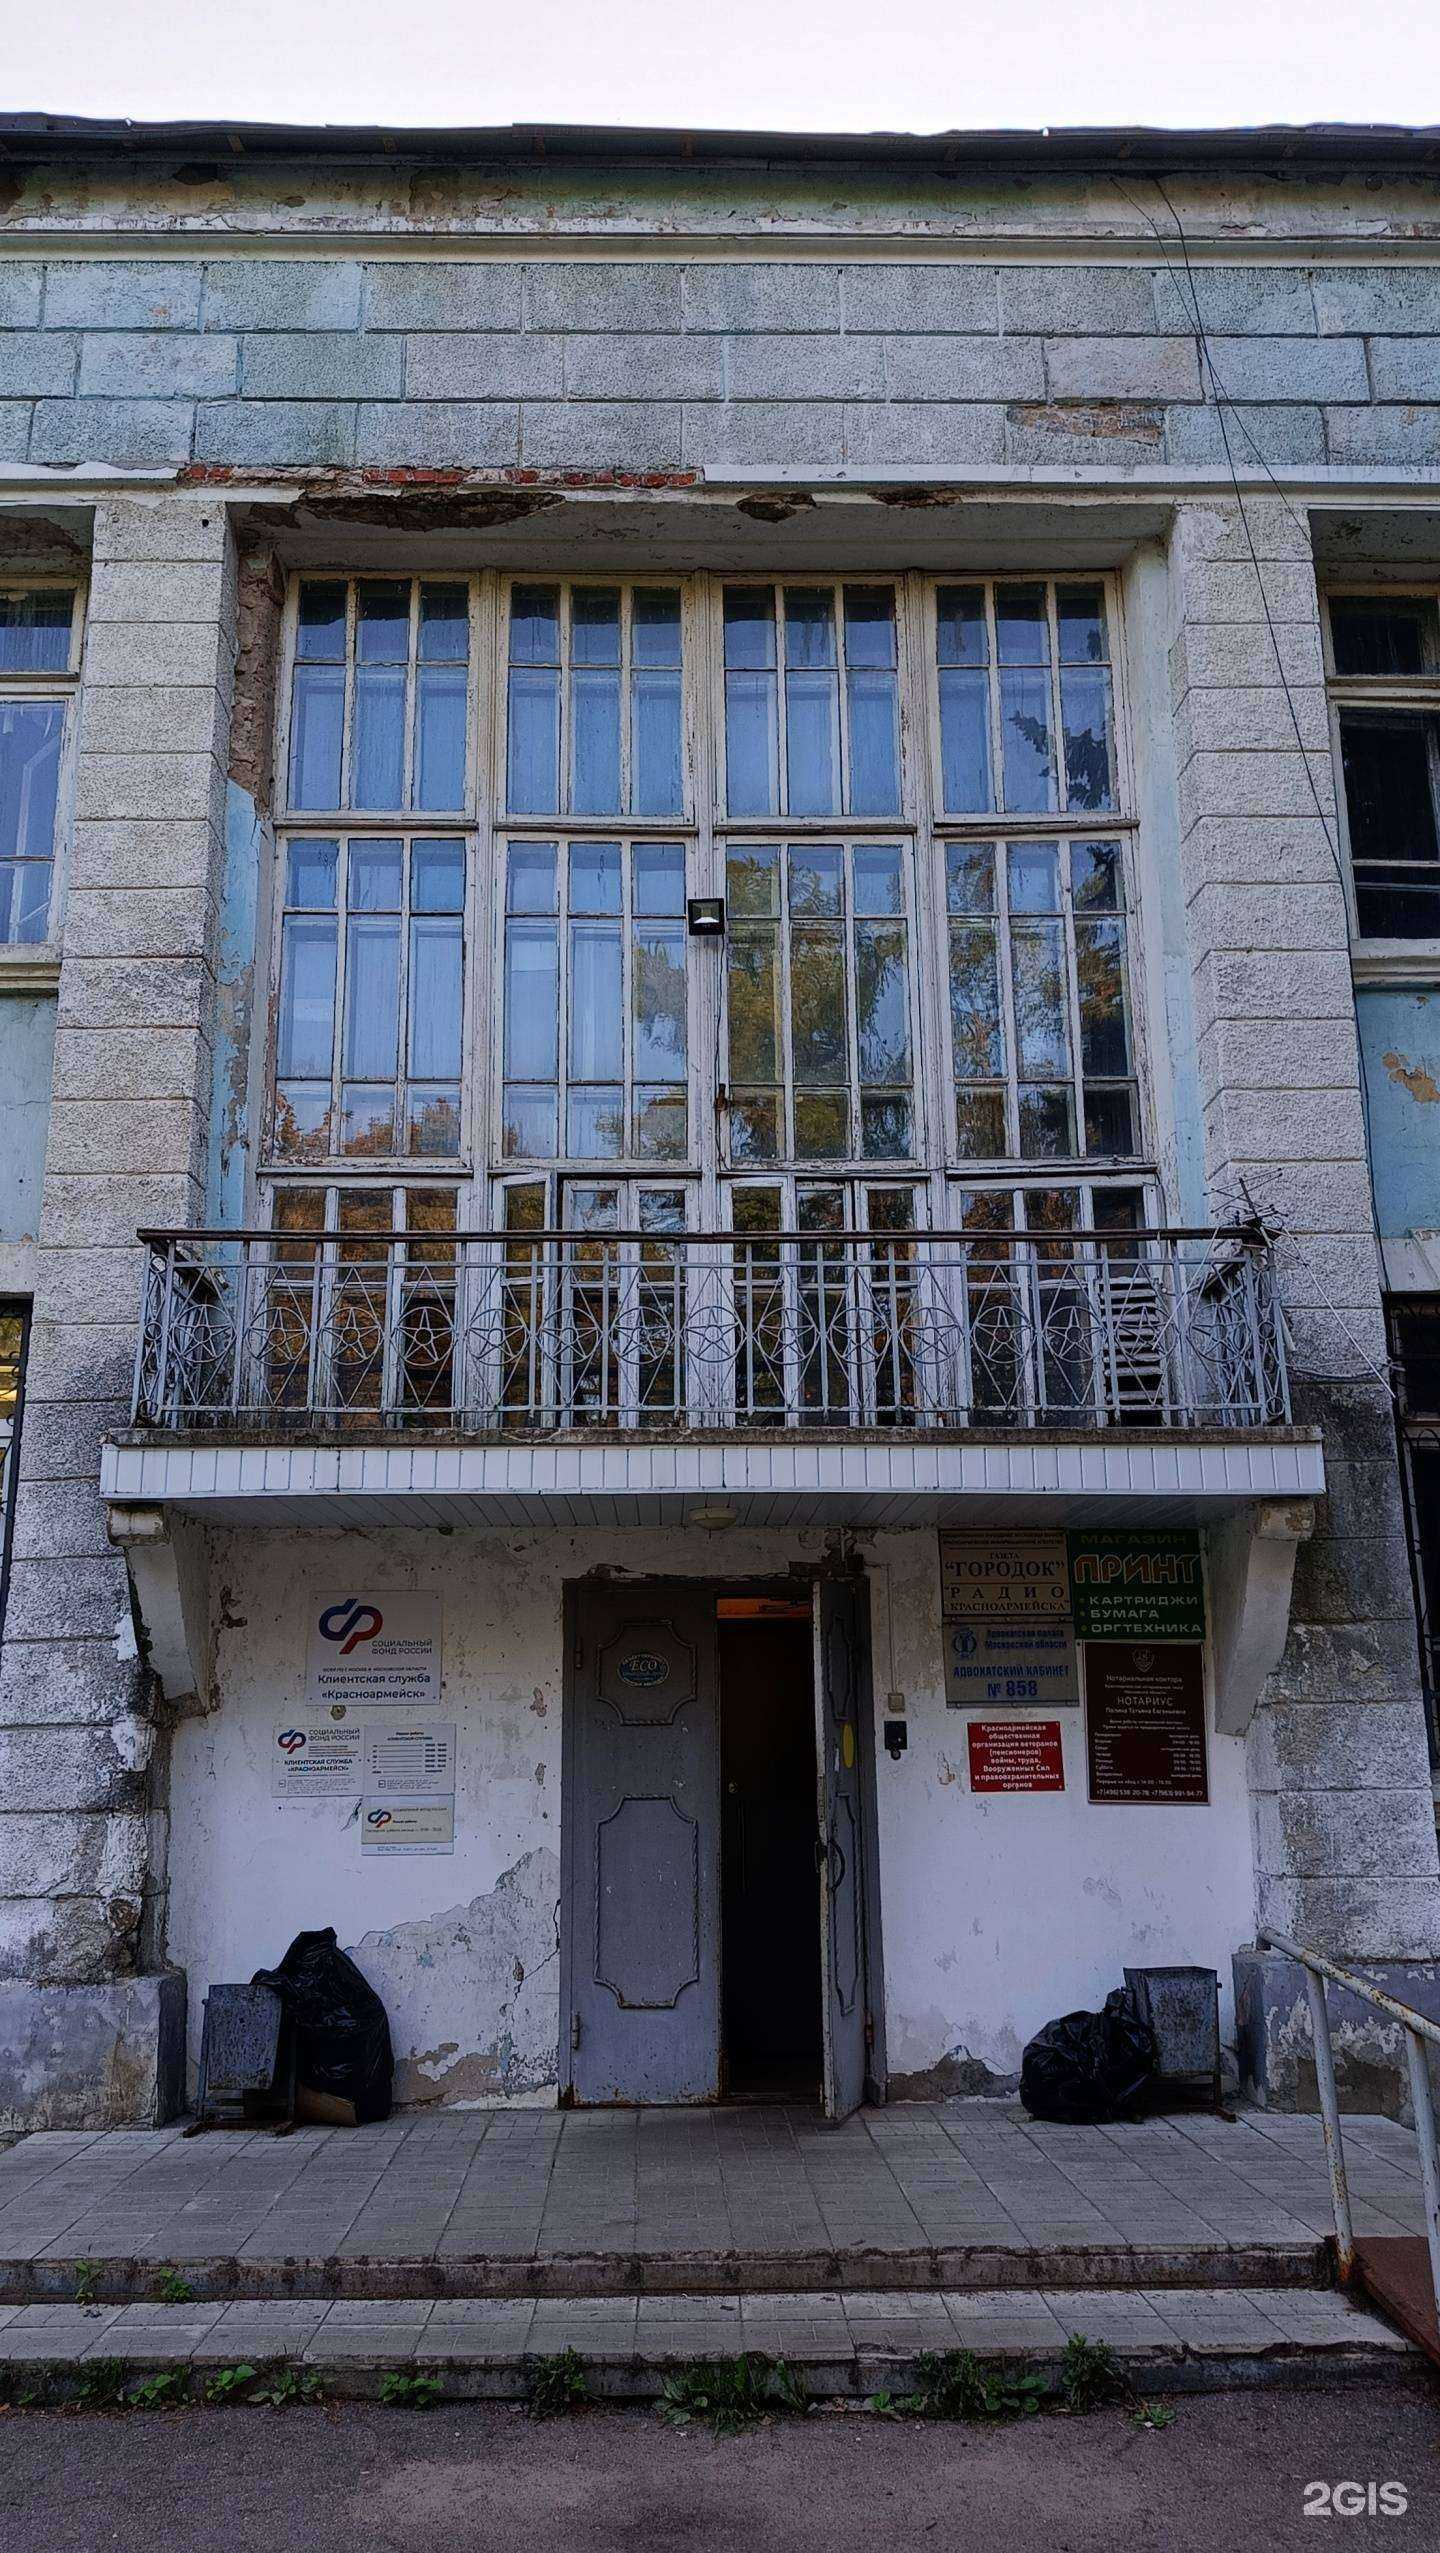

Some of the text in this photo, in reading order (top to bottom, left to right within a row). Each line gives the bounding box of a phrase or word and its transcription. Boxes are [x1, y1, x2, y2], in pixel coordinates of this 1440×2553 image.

[1081, 1535, 1185, 1544] МАГАЗИН
[1074, 1553, 1200, 1584] ПРИНТ
[1089, 1596, 1198, 1605] КАРТРИДЖИ
[1090, 1609, 1159, 1618] БУМАГА
[1091, 1624, 1202, 1632] ОРГТЕХНИКА
[371, 1639, 433, 1648] СОЦИАЛЬНЫЙ
[371, 1647, 433, 1655] ФОНД РОССИИ
[954, 1665, 1069, 1677] АДВОКАТСКИЙ КАБИНЕТ
[318, 1673, 431, 1684] Клиентская служба
[988, 1680, 1038, 1697] № 858
[322, 1689, 425, 1700] «Красноармейск»
[1117, 1696, 1173, 1706] НОТАРИУС
[989, 1749, 1041, 1757] (пенсионеров)
